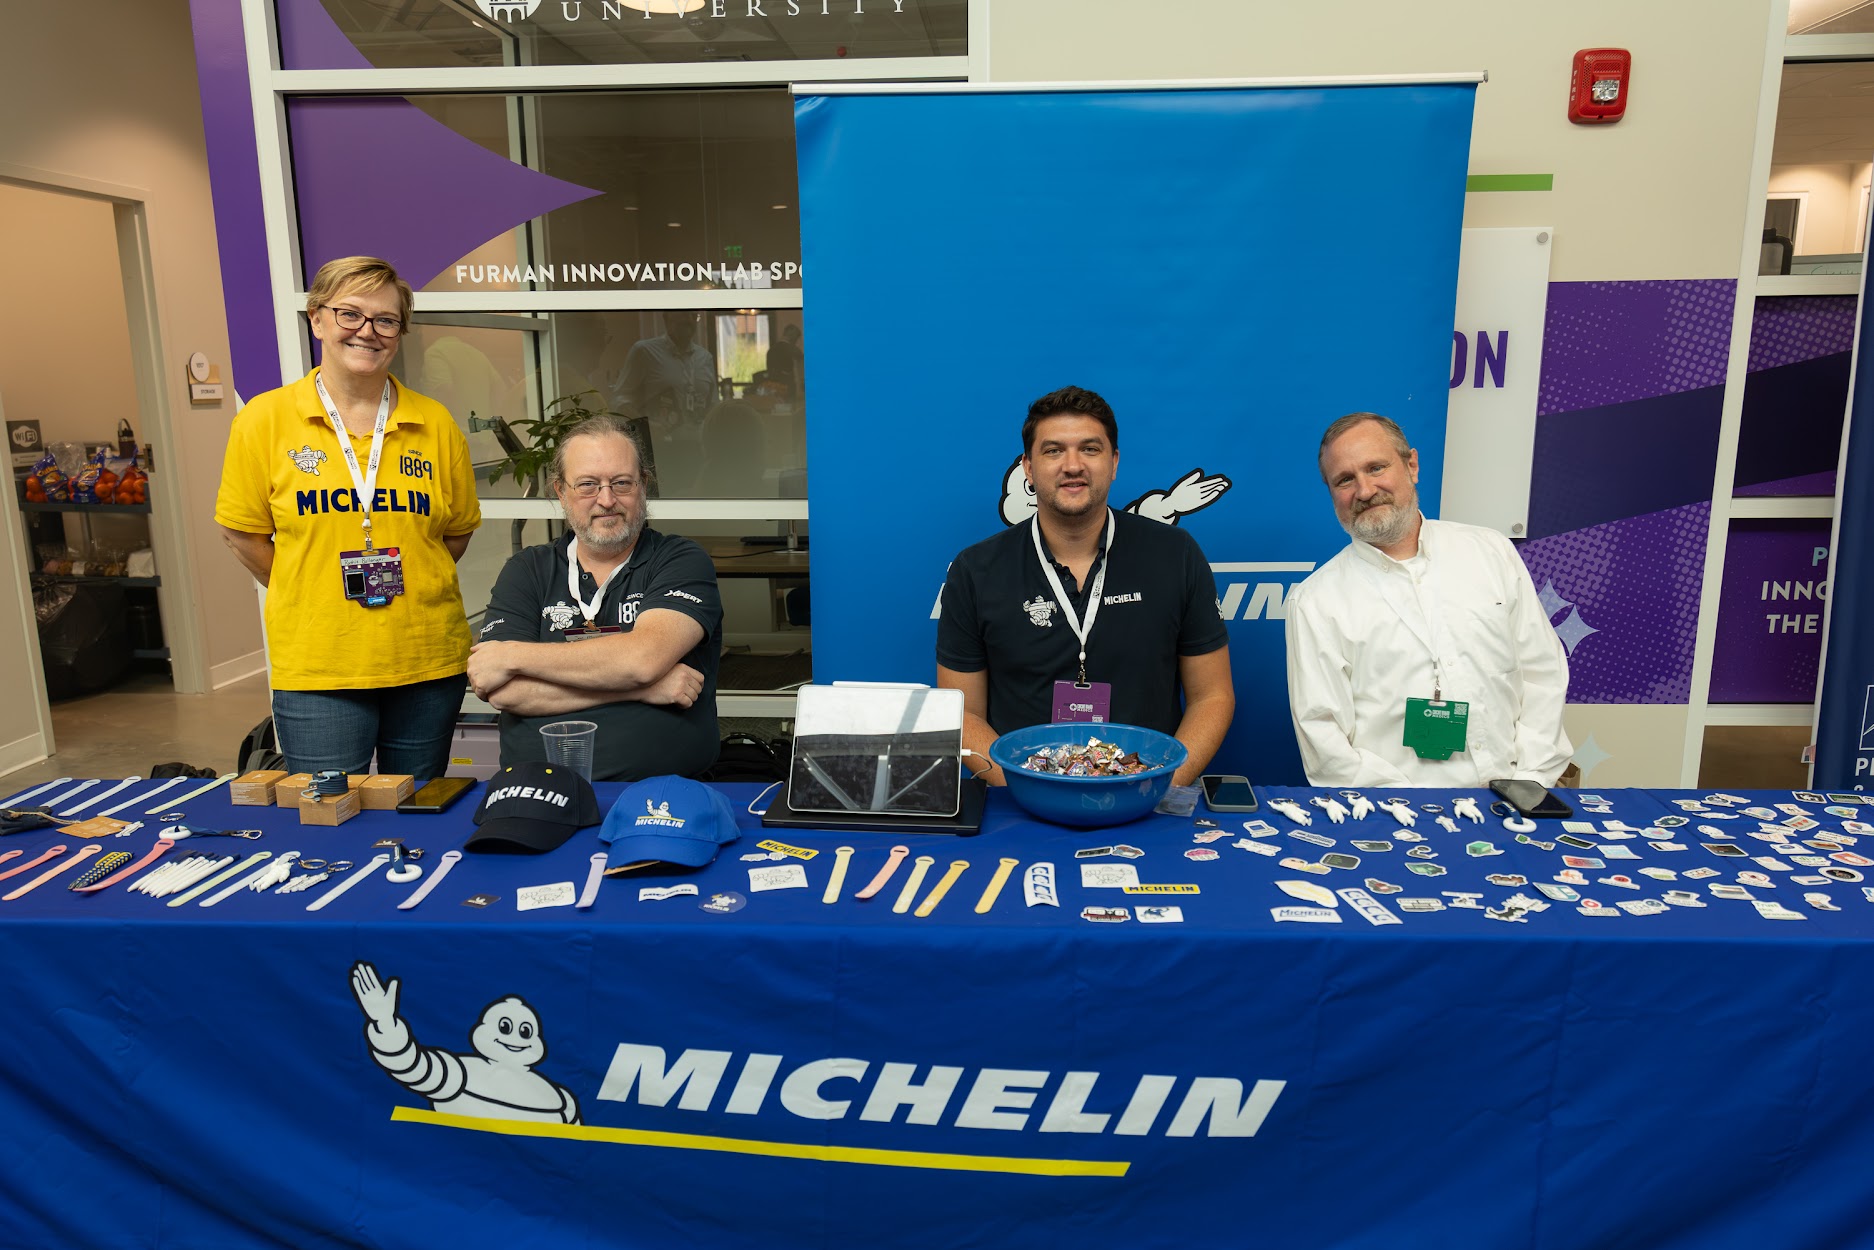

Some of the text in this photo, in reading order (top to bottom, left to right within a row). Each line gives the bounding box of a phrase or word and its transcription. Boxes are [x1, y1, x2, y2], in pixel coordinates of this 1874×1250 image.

[561, 0, 904, 21] UNIVERSITY
[456, 262, 802, 283] FURMAN INNOVATION LAB SP
[400, 455, 432, 480] 1889
[626, 592, 644, 600] SINCE
[1104, 592, 1142, 605] MICHELIN
[1766, 614, 1819, 633] THE
[485, 785, 569, 809] MICHELIN
[635, 818, 685, 828] MICHELIN
[762, 841, 813, 858] MICHELIN
[596, 1043, 1287, 1137] MICHELIN
